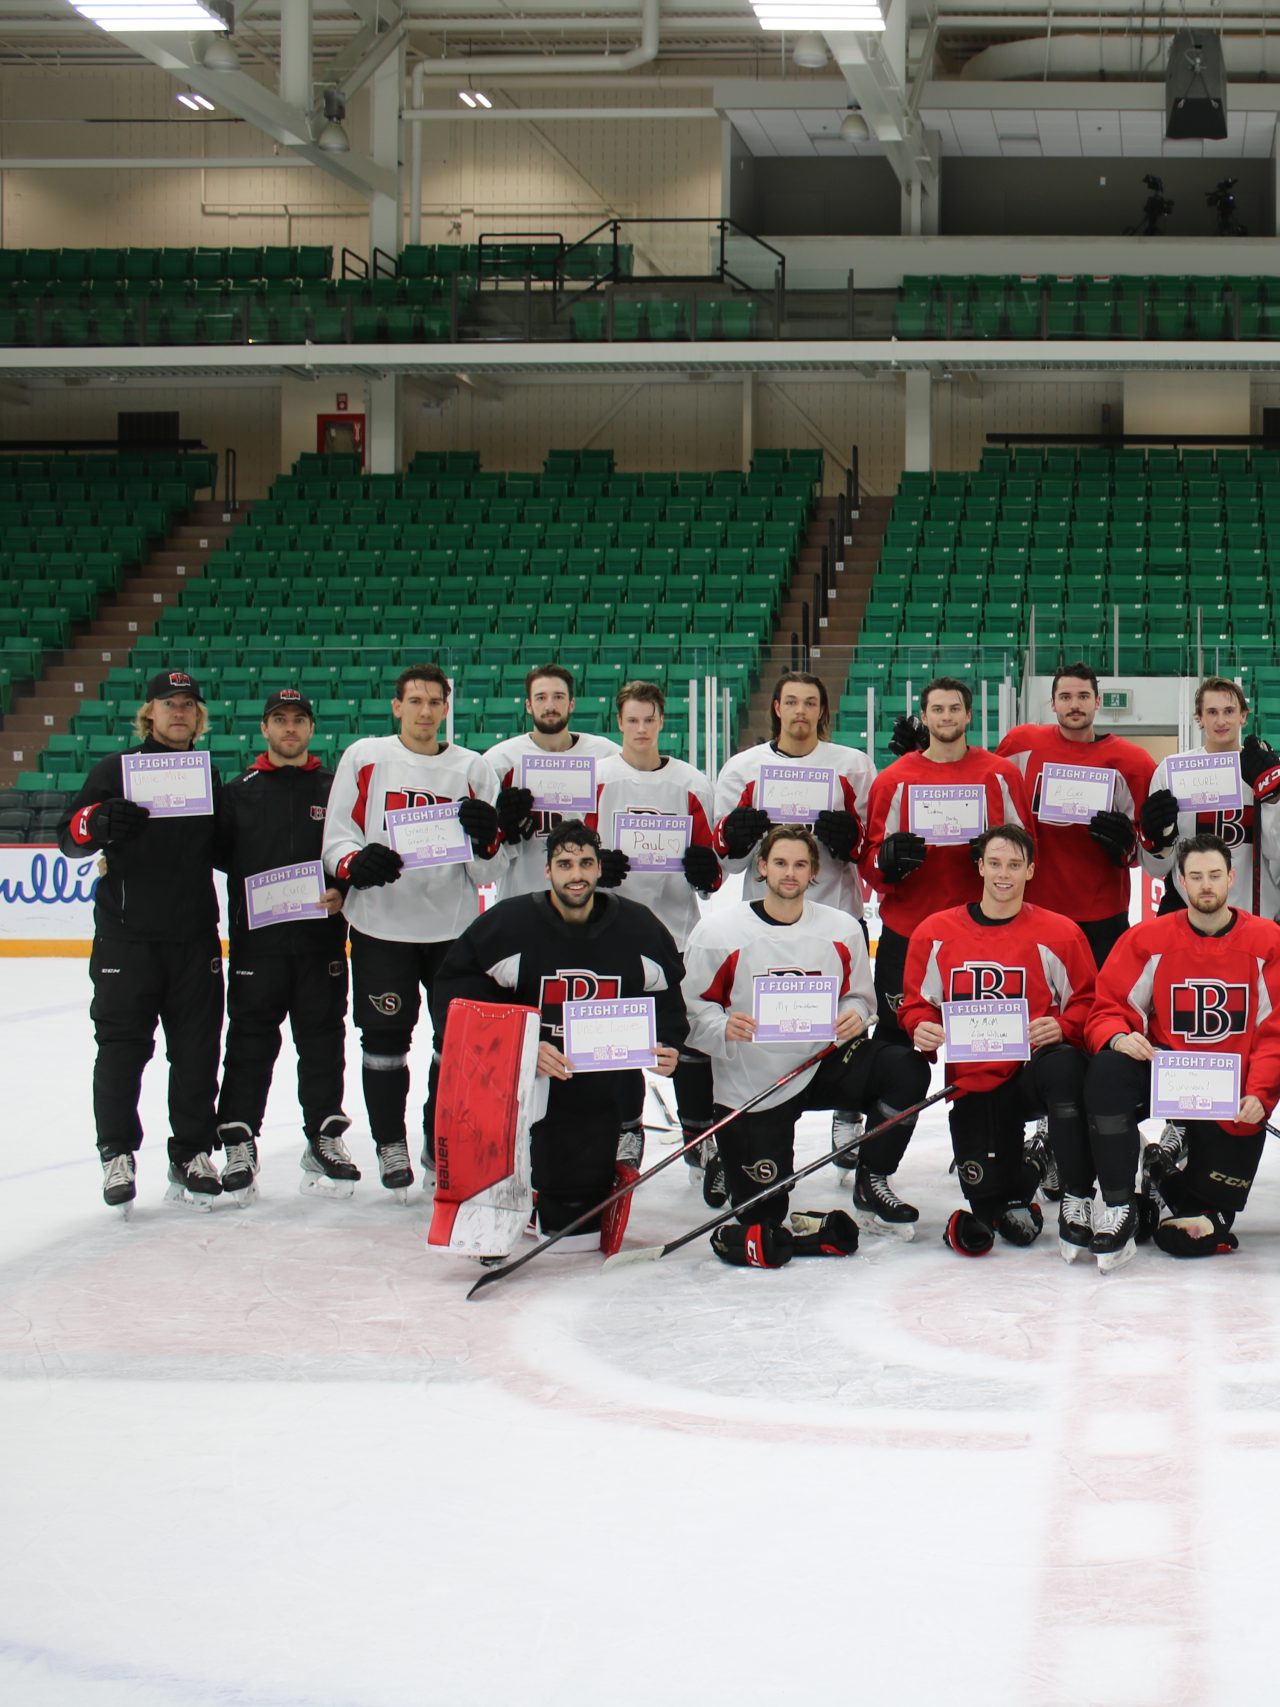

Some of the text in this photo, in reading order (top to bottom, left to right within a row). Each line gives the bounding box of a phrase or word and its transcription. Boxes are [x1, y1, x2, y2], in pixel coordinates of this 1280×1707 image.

[129, 756, 203, 769] I FIGHT FOR
[526, 758, 590, 768] I FIGHT FOR
[1170, 756, 1234, 770] I FIGHT FOR
[764, 768, 829, 780] I FIGHT FOR
[1048, 768, 1109, 781] I FIGHT FOR
[1192, 773, 1218, 786] CURE!
[914, 789, 978, 798] I FIGHT FOR
[391, 807, 459, 824] I FIGHT FOR
[620, 818, 686, 828] I FIGHT FOR
[1214, 808, 1247, 849] B
[633, 831, 665, 851] Paul
[251, 865, 317, 888] I FIGHT FOR
[265, 891, 273, 904] A
[759, 981, 832, 991] I FIGHT FOR
[570, 1003, 647, 1017] I FIGHT FOR
[948, 1003, 1021, 1014] I FIGHT FOR
[1187, 981, 1231, 1041] B
[969, 1017, 978, 1028] My
[836, 1037, 866, 1064] CC
[1158, 1056, 1233, 1068] I FIGHT FOR
[438, 1136, 450, 1190] BAUER
[1209, 1171, 1251, 1188] CCM
